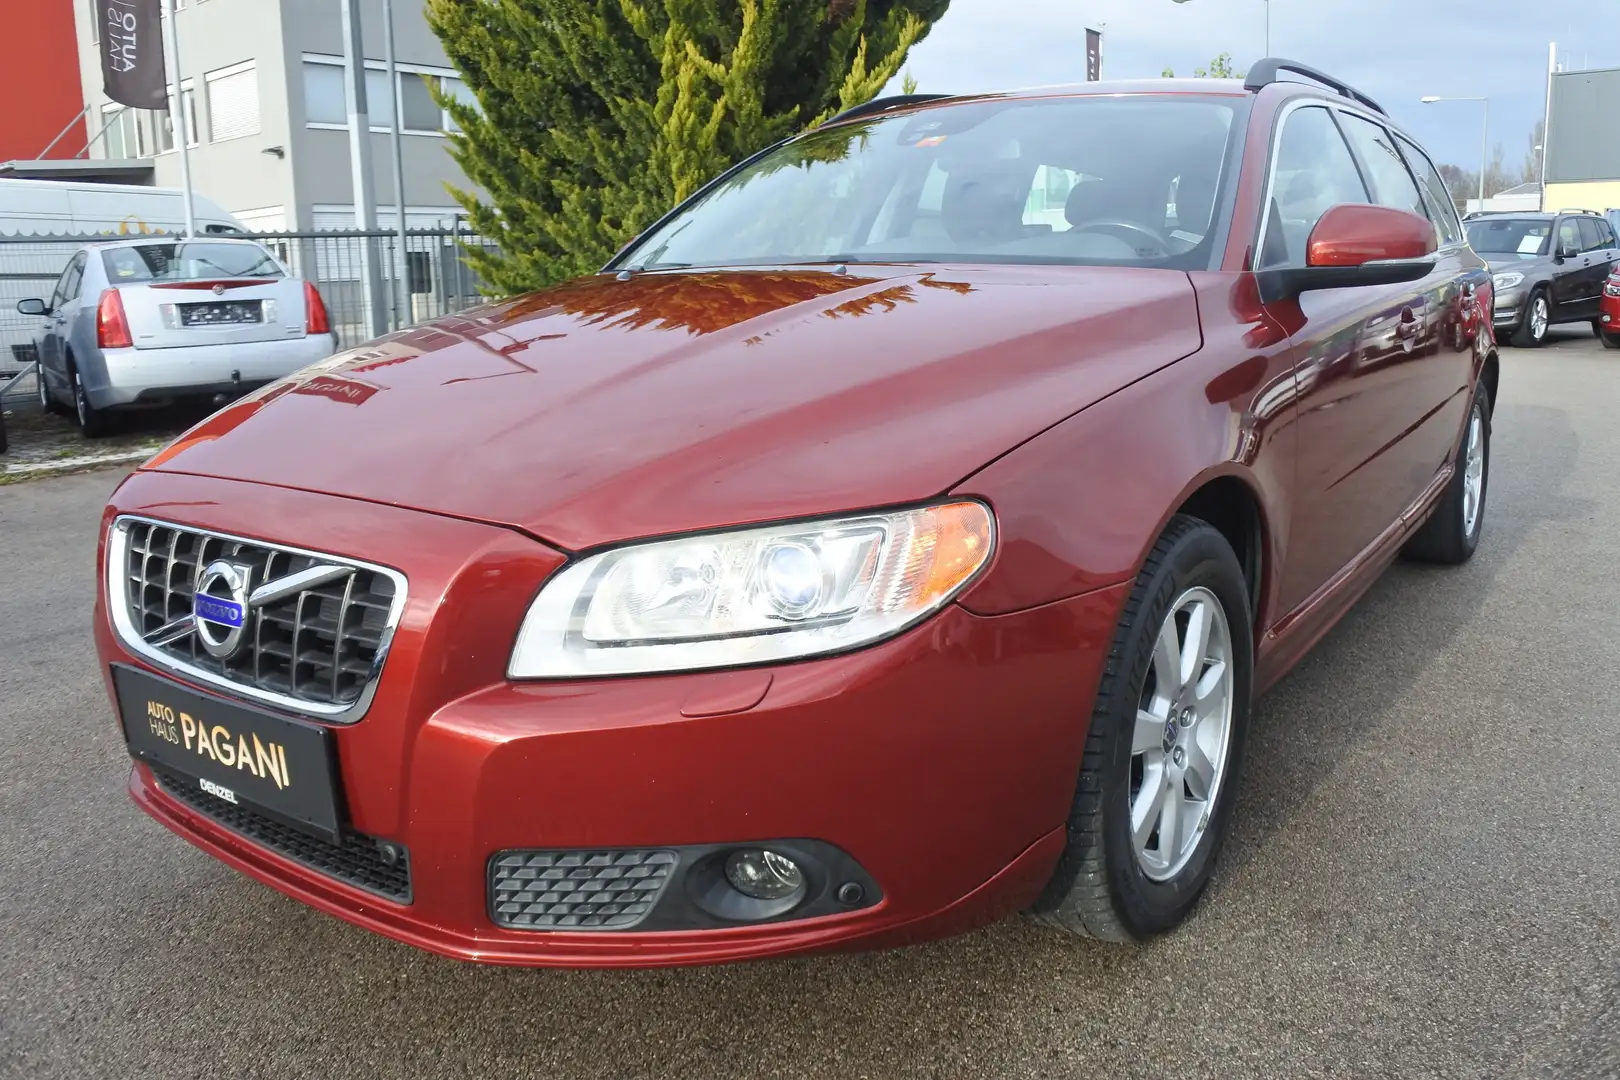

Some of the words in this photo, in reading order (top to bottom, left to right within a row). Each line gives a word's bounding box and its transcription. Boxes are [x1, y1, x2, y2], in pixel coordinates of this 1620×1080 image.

[147, 701, 175, 724] AUTO
[149, 717, 179, 745] HAUS
[179, 712, 290, 791] PAGANI
[200, 778, 238, 804] DENZEL
